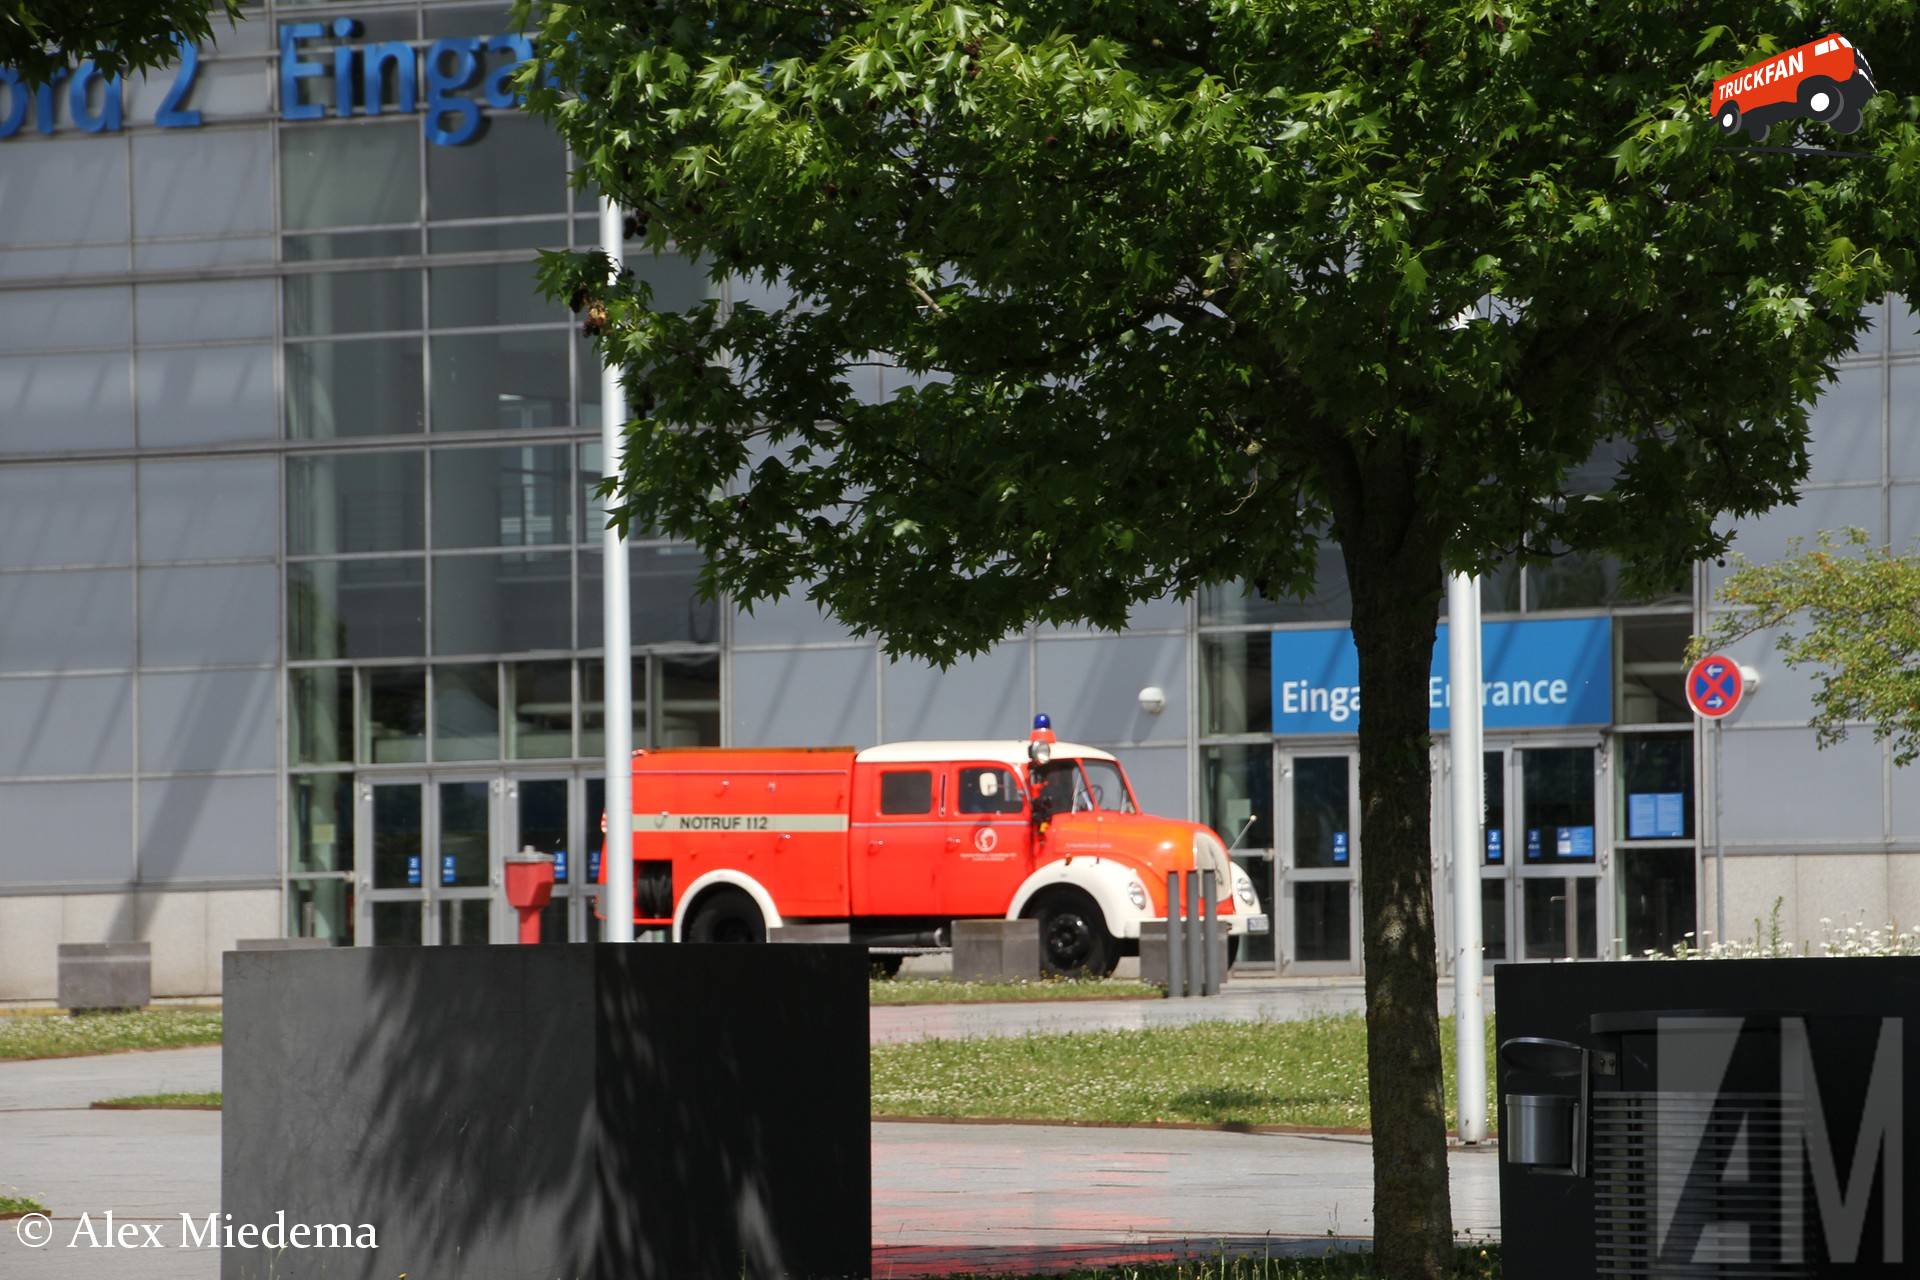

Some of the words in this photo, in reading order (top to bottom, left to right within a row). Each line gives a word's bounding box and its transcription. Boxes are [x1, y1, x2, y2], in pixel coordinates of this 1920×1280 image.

[155, 31, 202, 128] 2
[280, 17, 560, 146] Einga
[1283, 680, 1360, 722] Einga
[1429, 676, 1569, 708] Erance
[680, 816, 741, 830] NOTRUF
[746, 816, 768, 830] 112
